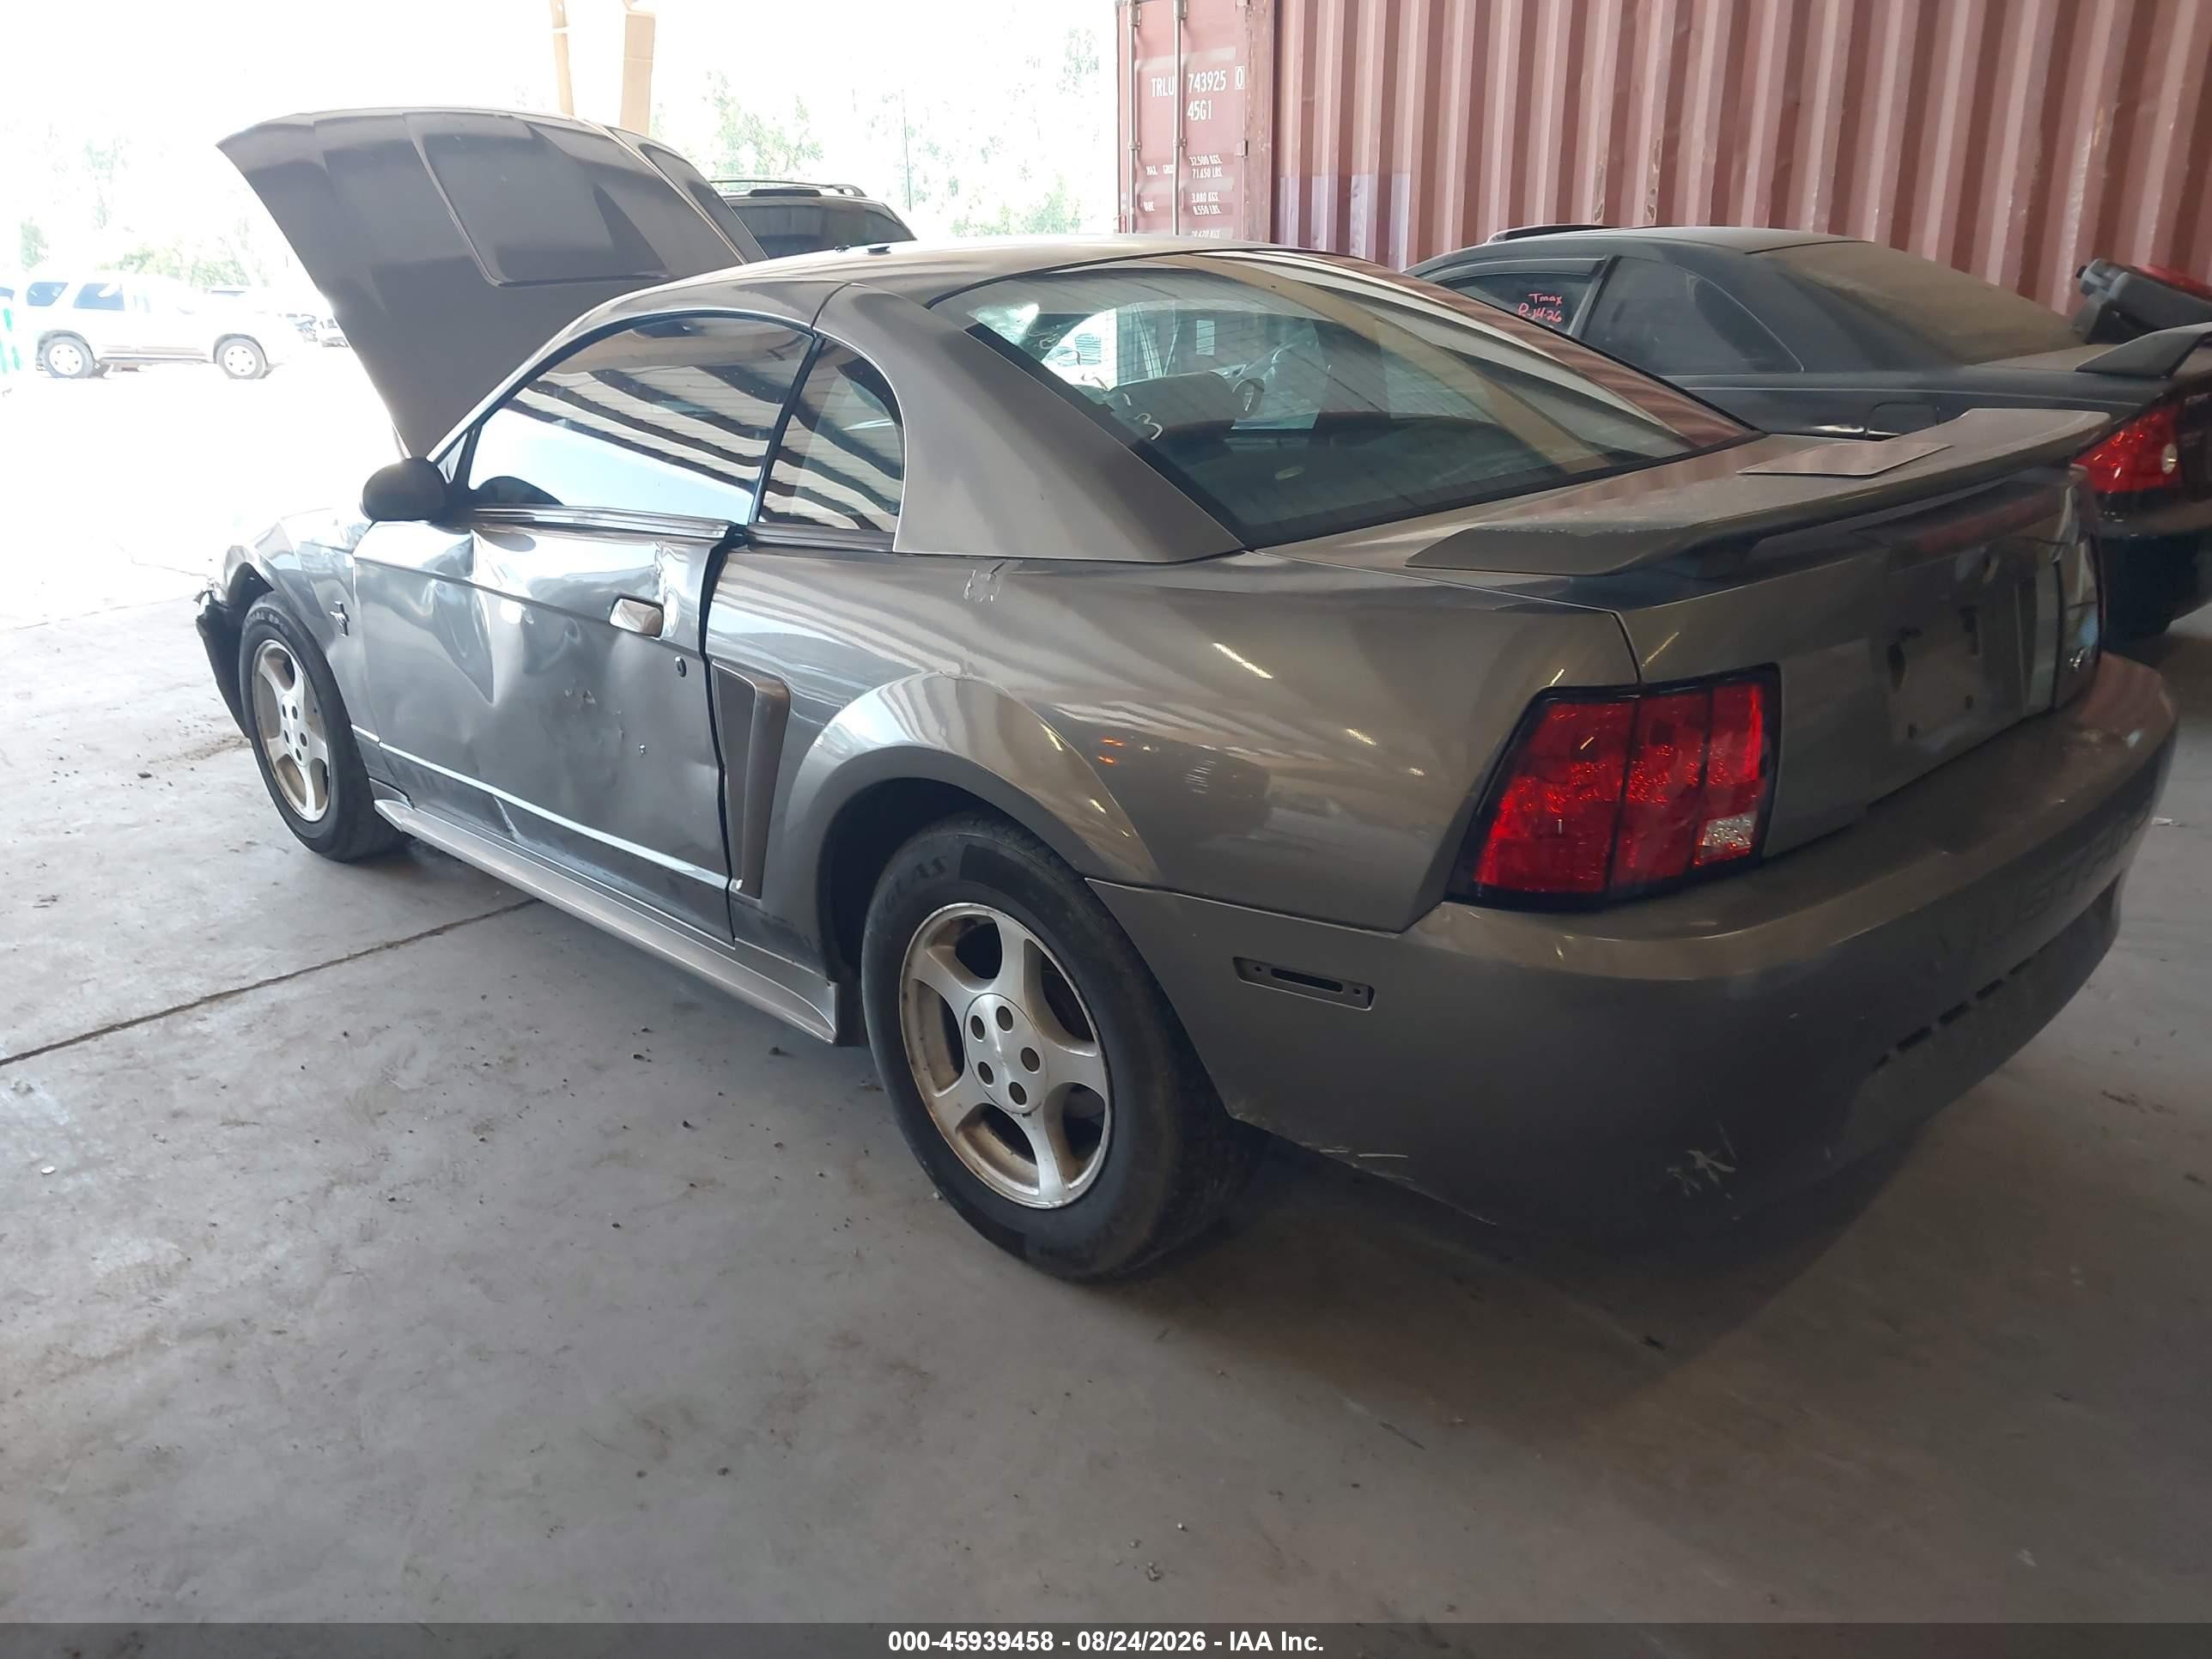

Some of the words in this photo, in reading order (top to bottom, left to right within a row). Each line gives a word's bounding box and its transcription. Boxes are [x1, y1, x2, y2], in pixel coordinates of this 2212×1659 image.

[1151, 76, 1176, 97] TRLU
[1188, 69, 1227, 94] 743925
[1528, 293, 1563, 307] Tmax
